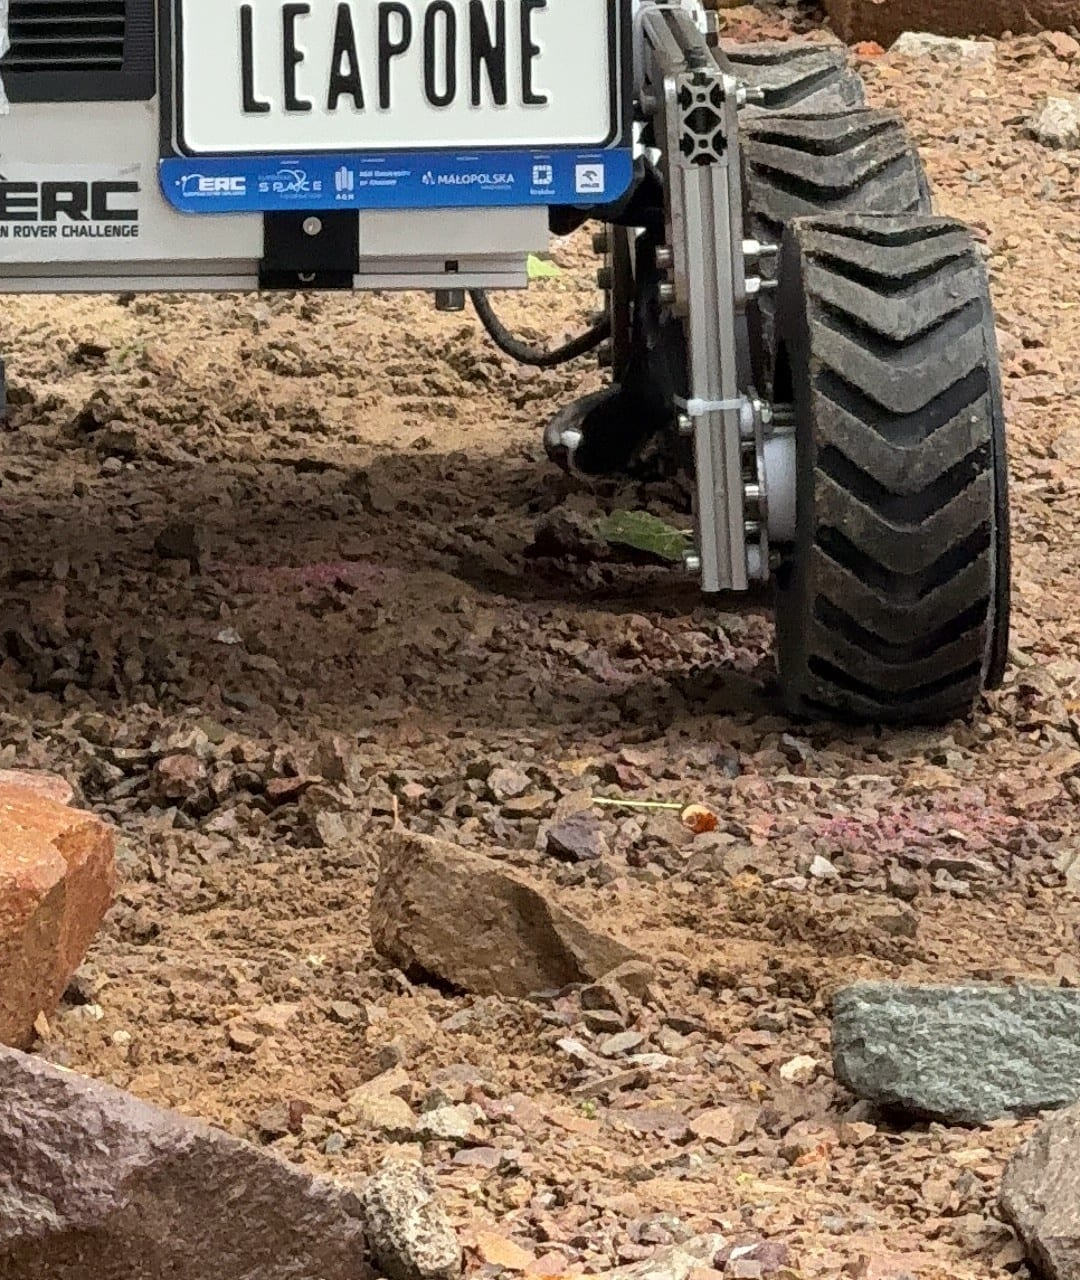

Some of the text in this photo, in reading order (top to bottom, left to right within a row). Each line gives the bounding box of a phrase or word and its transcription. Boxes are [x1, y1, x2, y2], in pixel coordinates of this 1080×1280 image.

[437, 173, 515, 185] MAŁOPOLSKA
[13, 224, 58, 238] ROVER
[61, 224, 139, 238] CHALLENGE
